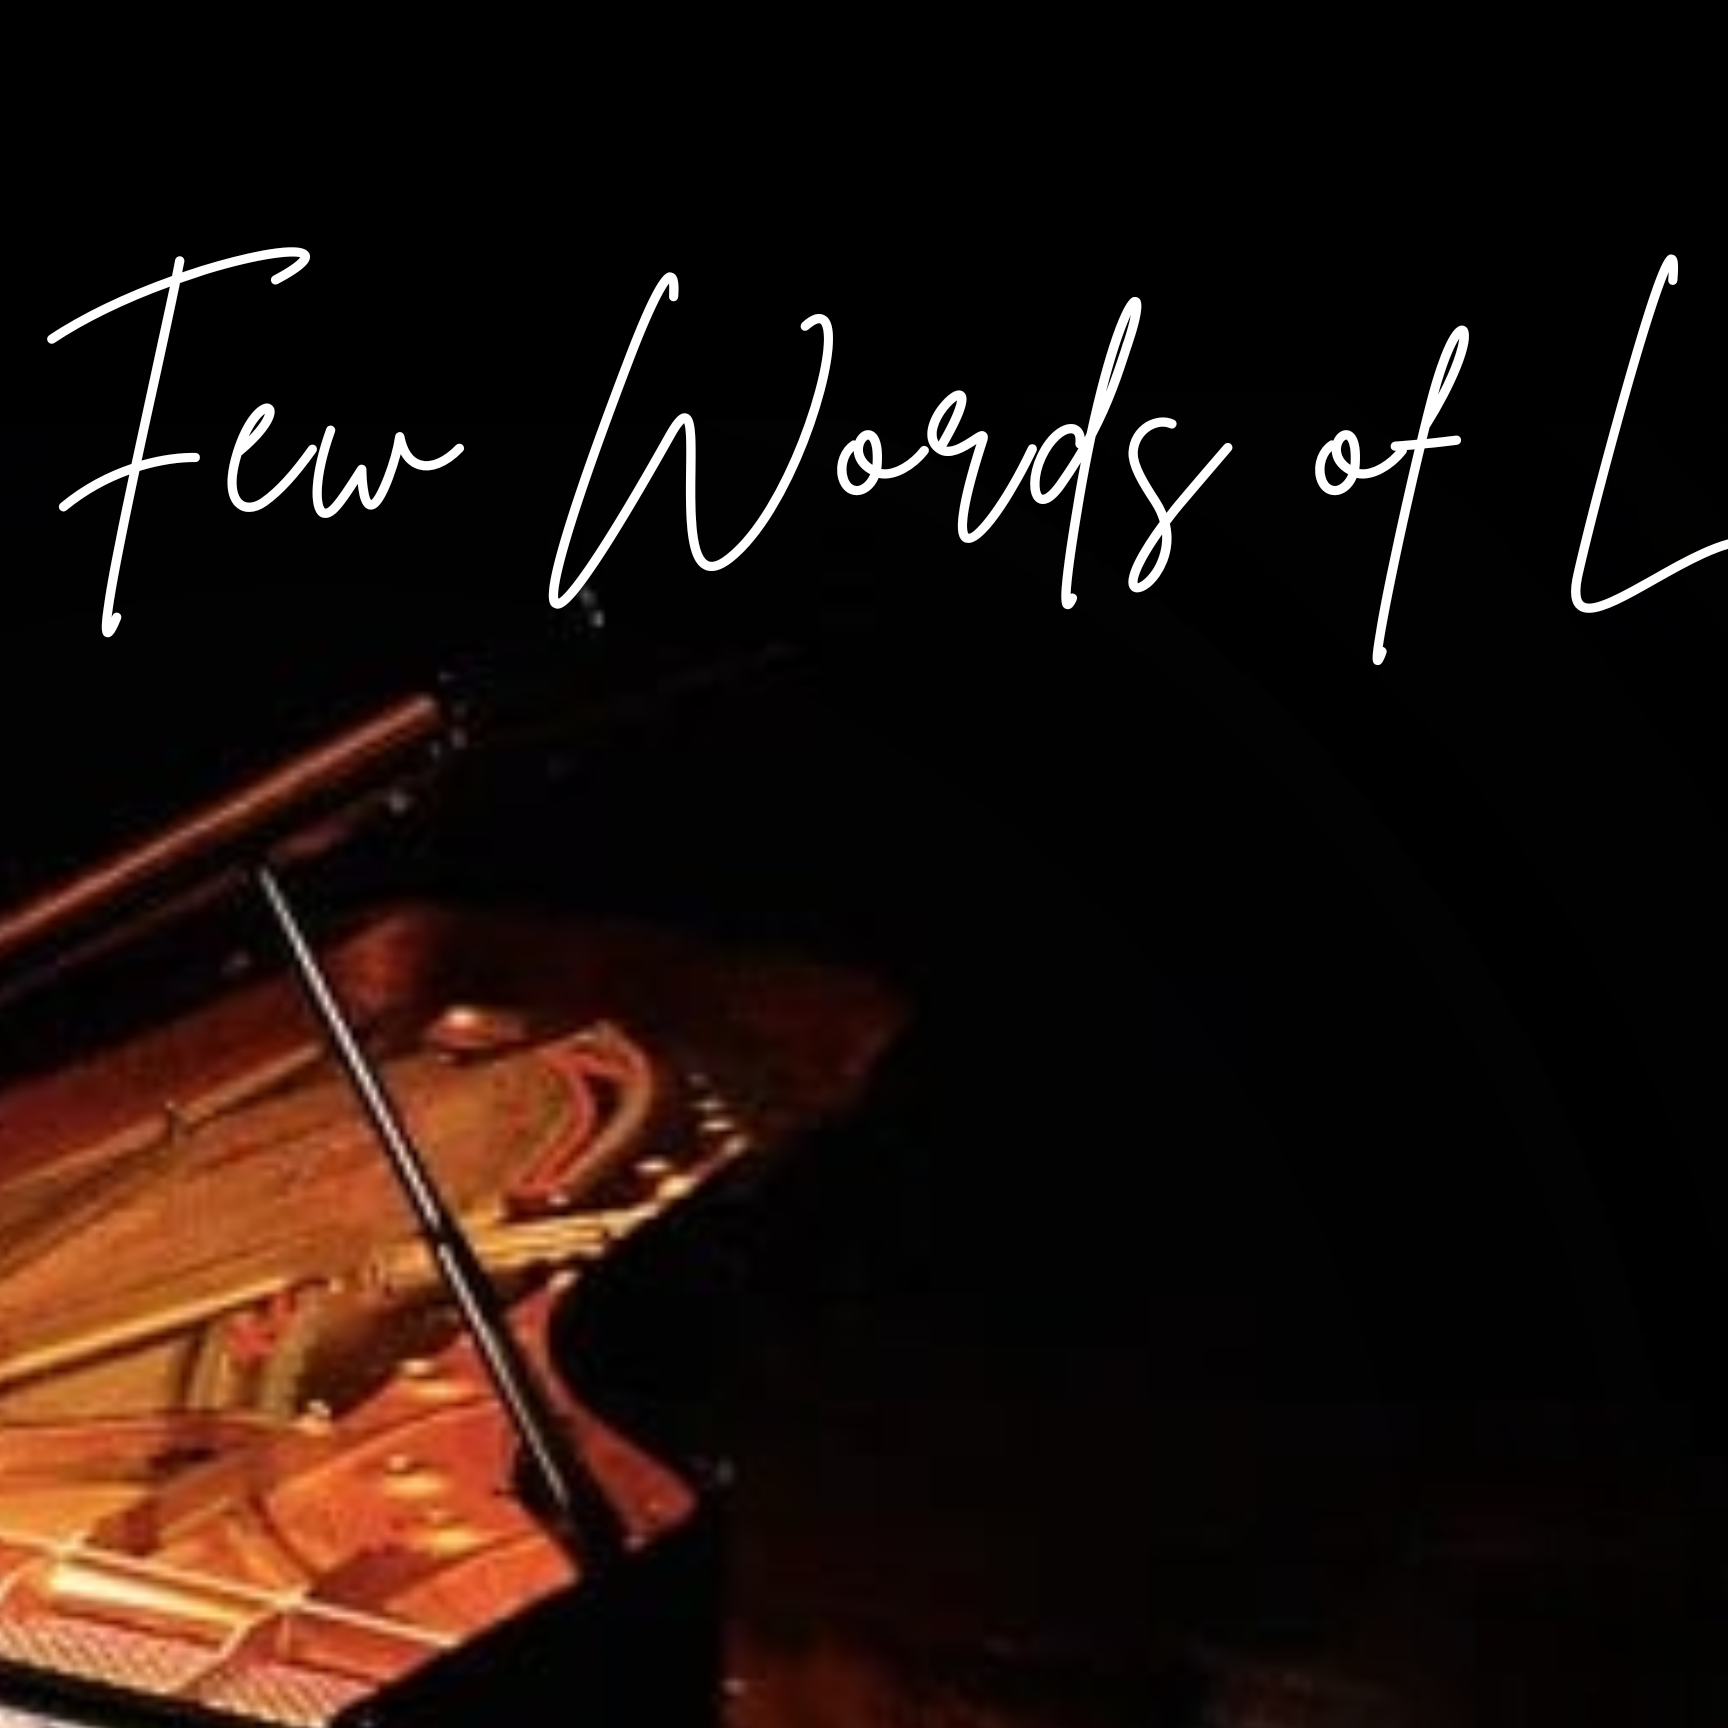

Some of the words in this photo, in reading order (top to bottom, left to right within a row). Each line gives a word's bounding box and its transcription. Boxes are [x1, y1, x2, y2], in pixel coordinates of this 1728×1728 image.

[46, 247, 466, 638] Few
[548, 272, 1234, 610] Words
[1313, 325, 1471, 666] of
